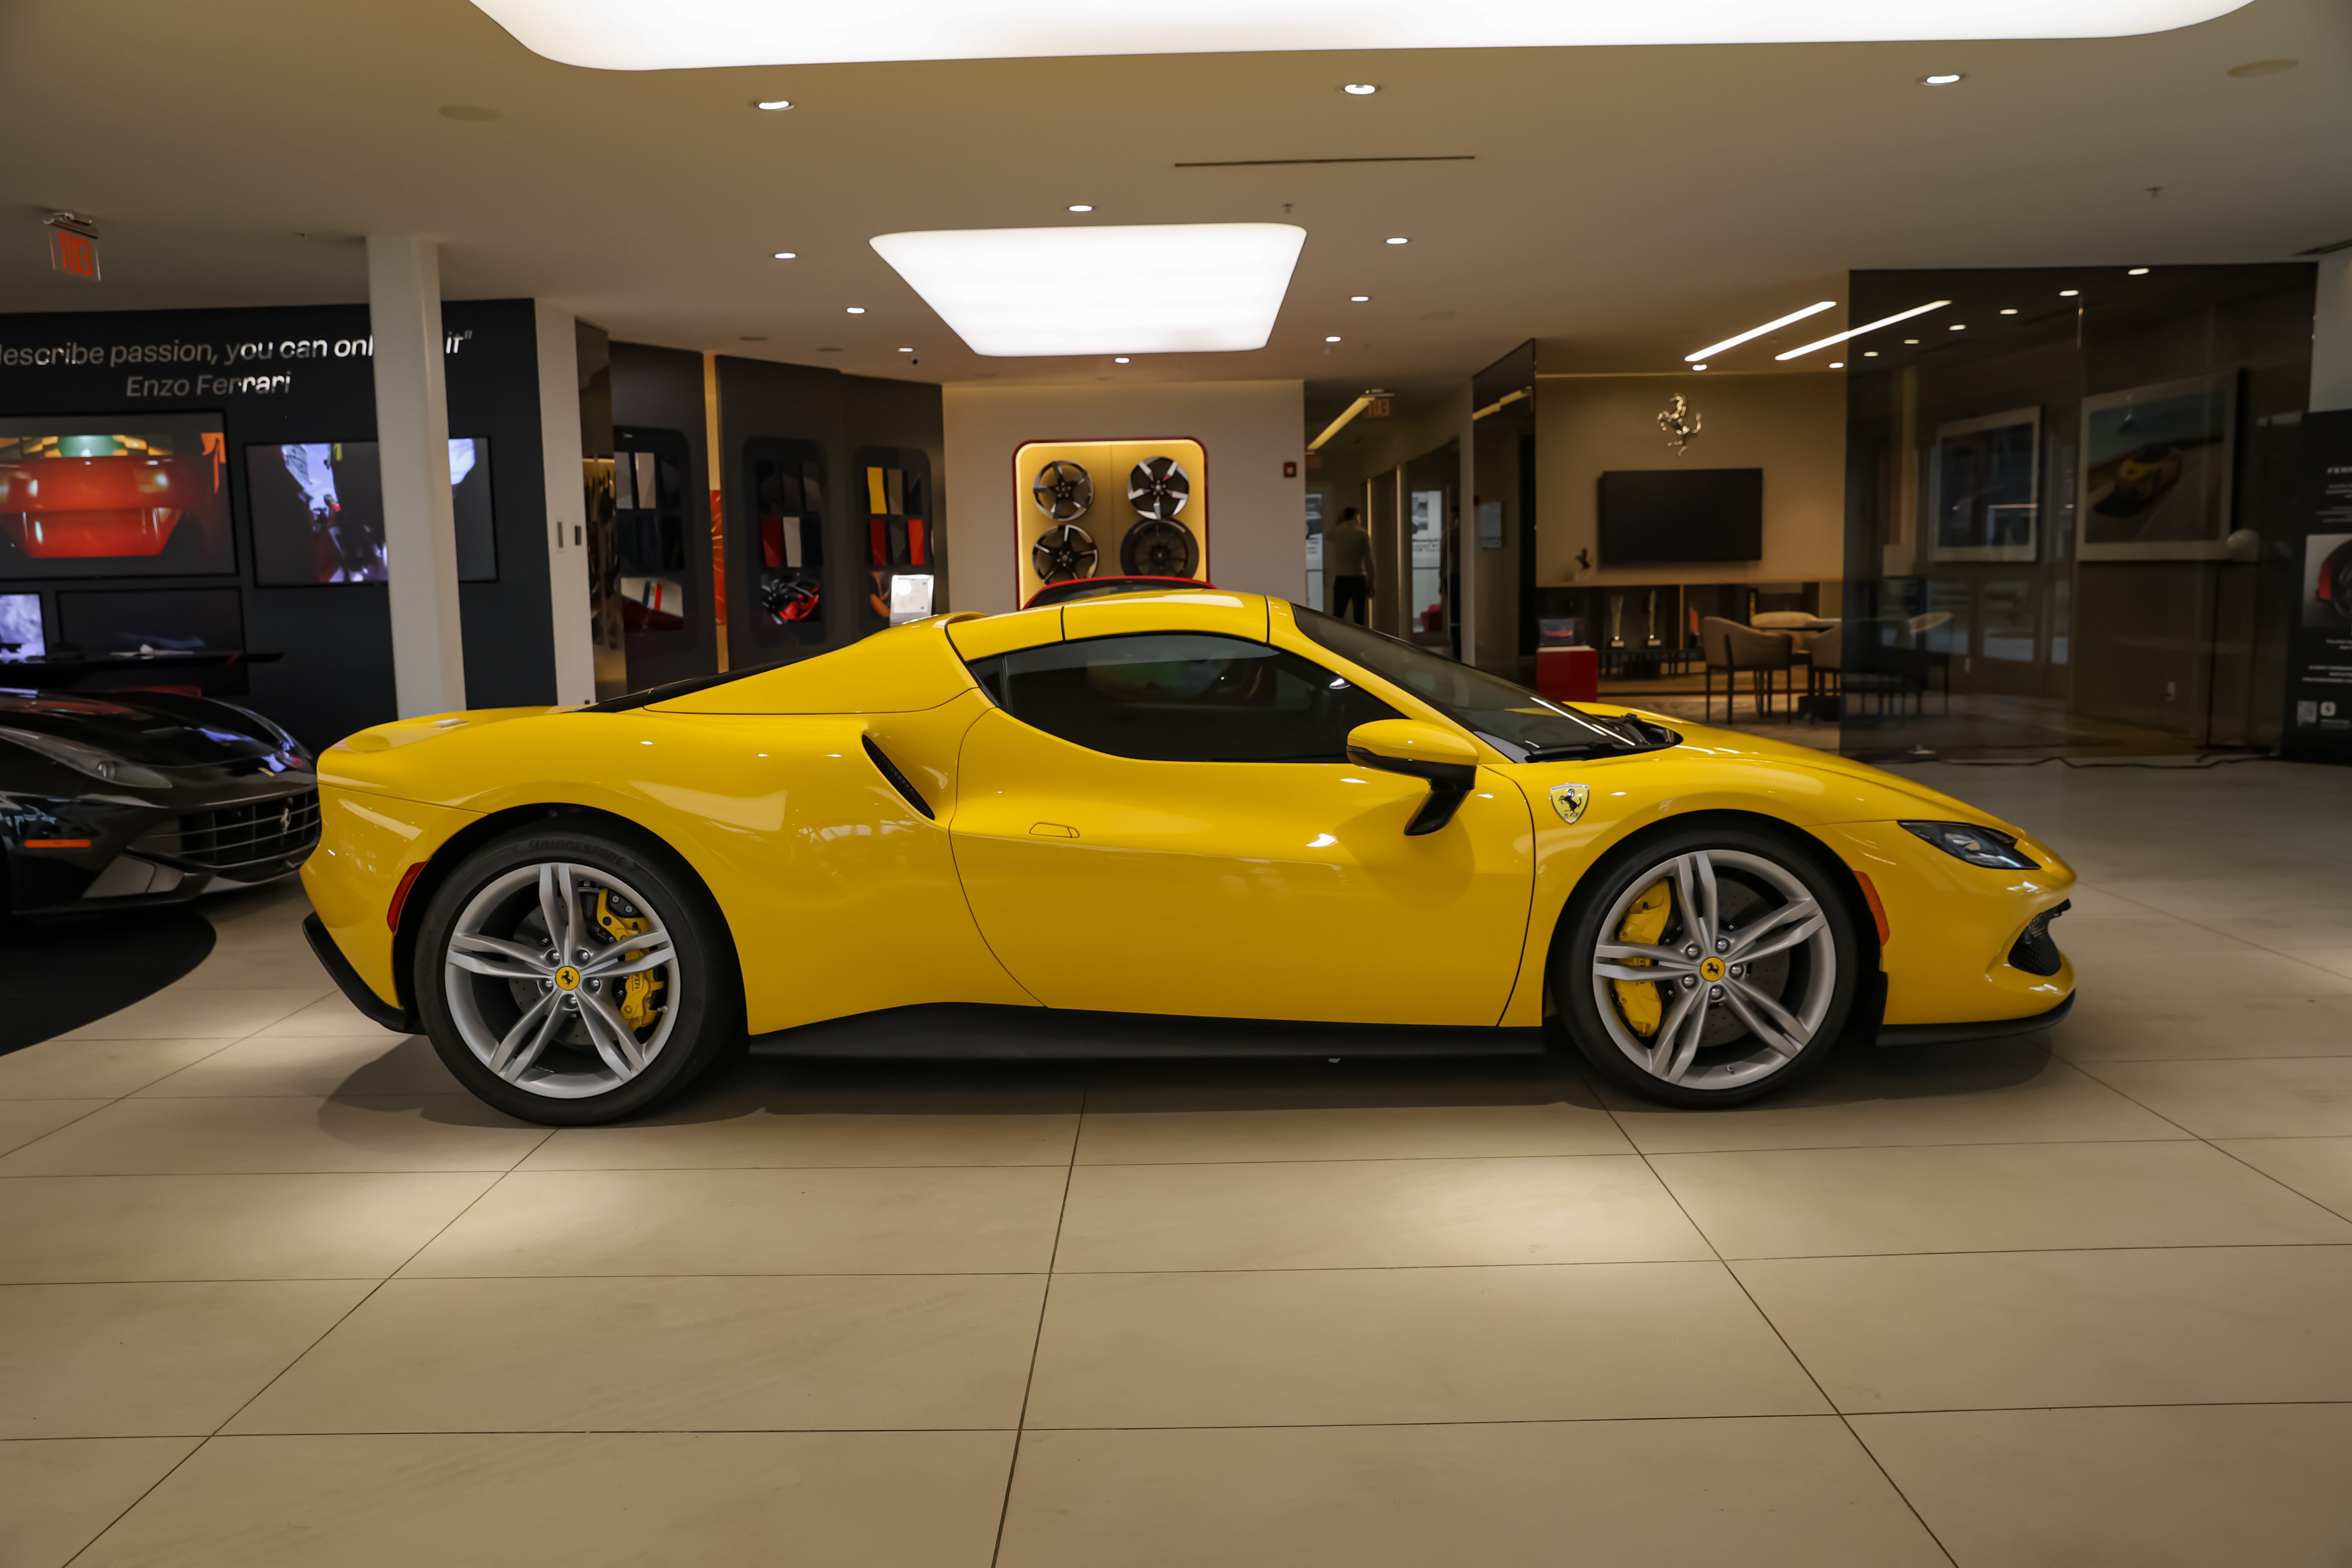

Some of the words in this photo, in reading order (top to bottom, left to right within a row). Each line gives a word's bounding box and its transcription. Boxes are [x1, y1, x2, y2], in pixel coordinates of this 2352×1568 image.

[110, 339, 217, 368] passion,
[224, 341, 273, 365] you
[280, 339, 327, 359] can
[334, 334, 373, 357] onl
[445, 330, 472, 354] it"
[127, 376, 190, 396] Enzo
[196, 370, 291, 395] Ferrari
[528, 840, 626, 866] BRIDGESTONE
